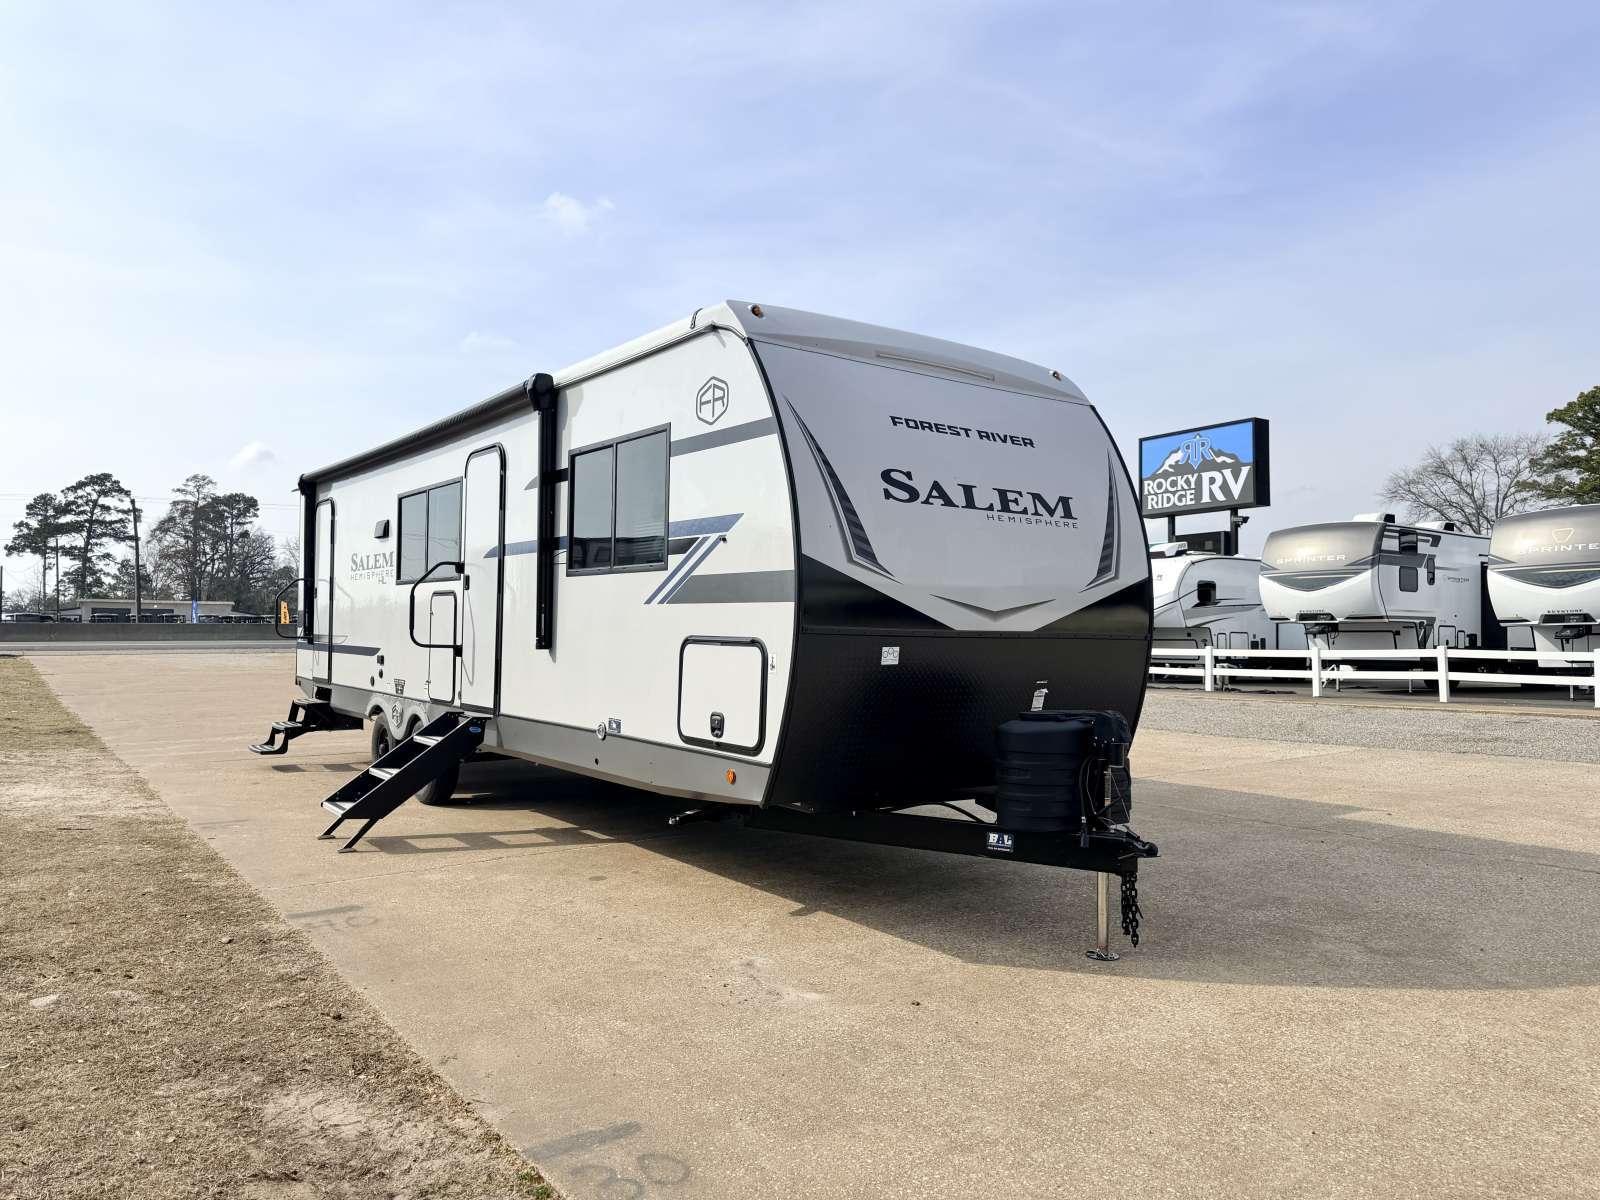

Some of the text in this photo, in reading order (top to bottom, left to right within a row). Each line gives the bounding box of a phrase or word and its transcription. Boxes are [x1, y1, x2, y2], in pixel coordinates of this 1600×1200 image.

[889, 415, 1036, 448] FOREST RIVER
[880, 468, 1079, 520] SALEM
[1143, 473, 1199, 495] ROCKY
[1200, 465, 1252, 503] RV
[1147, 490, 1196, 510] RIDGE
[986, 513, 1079, 529] HEMISPHERE
[351, 551, 395, 573] SALEM
